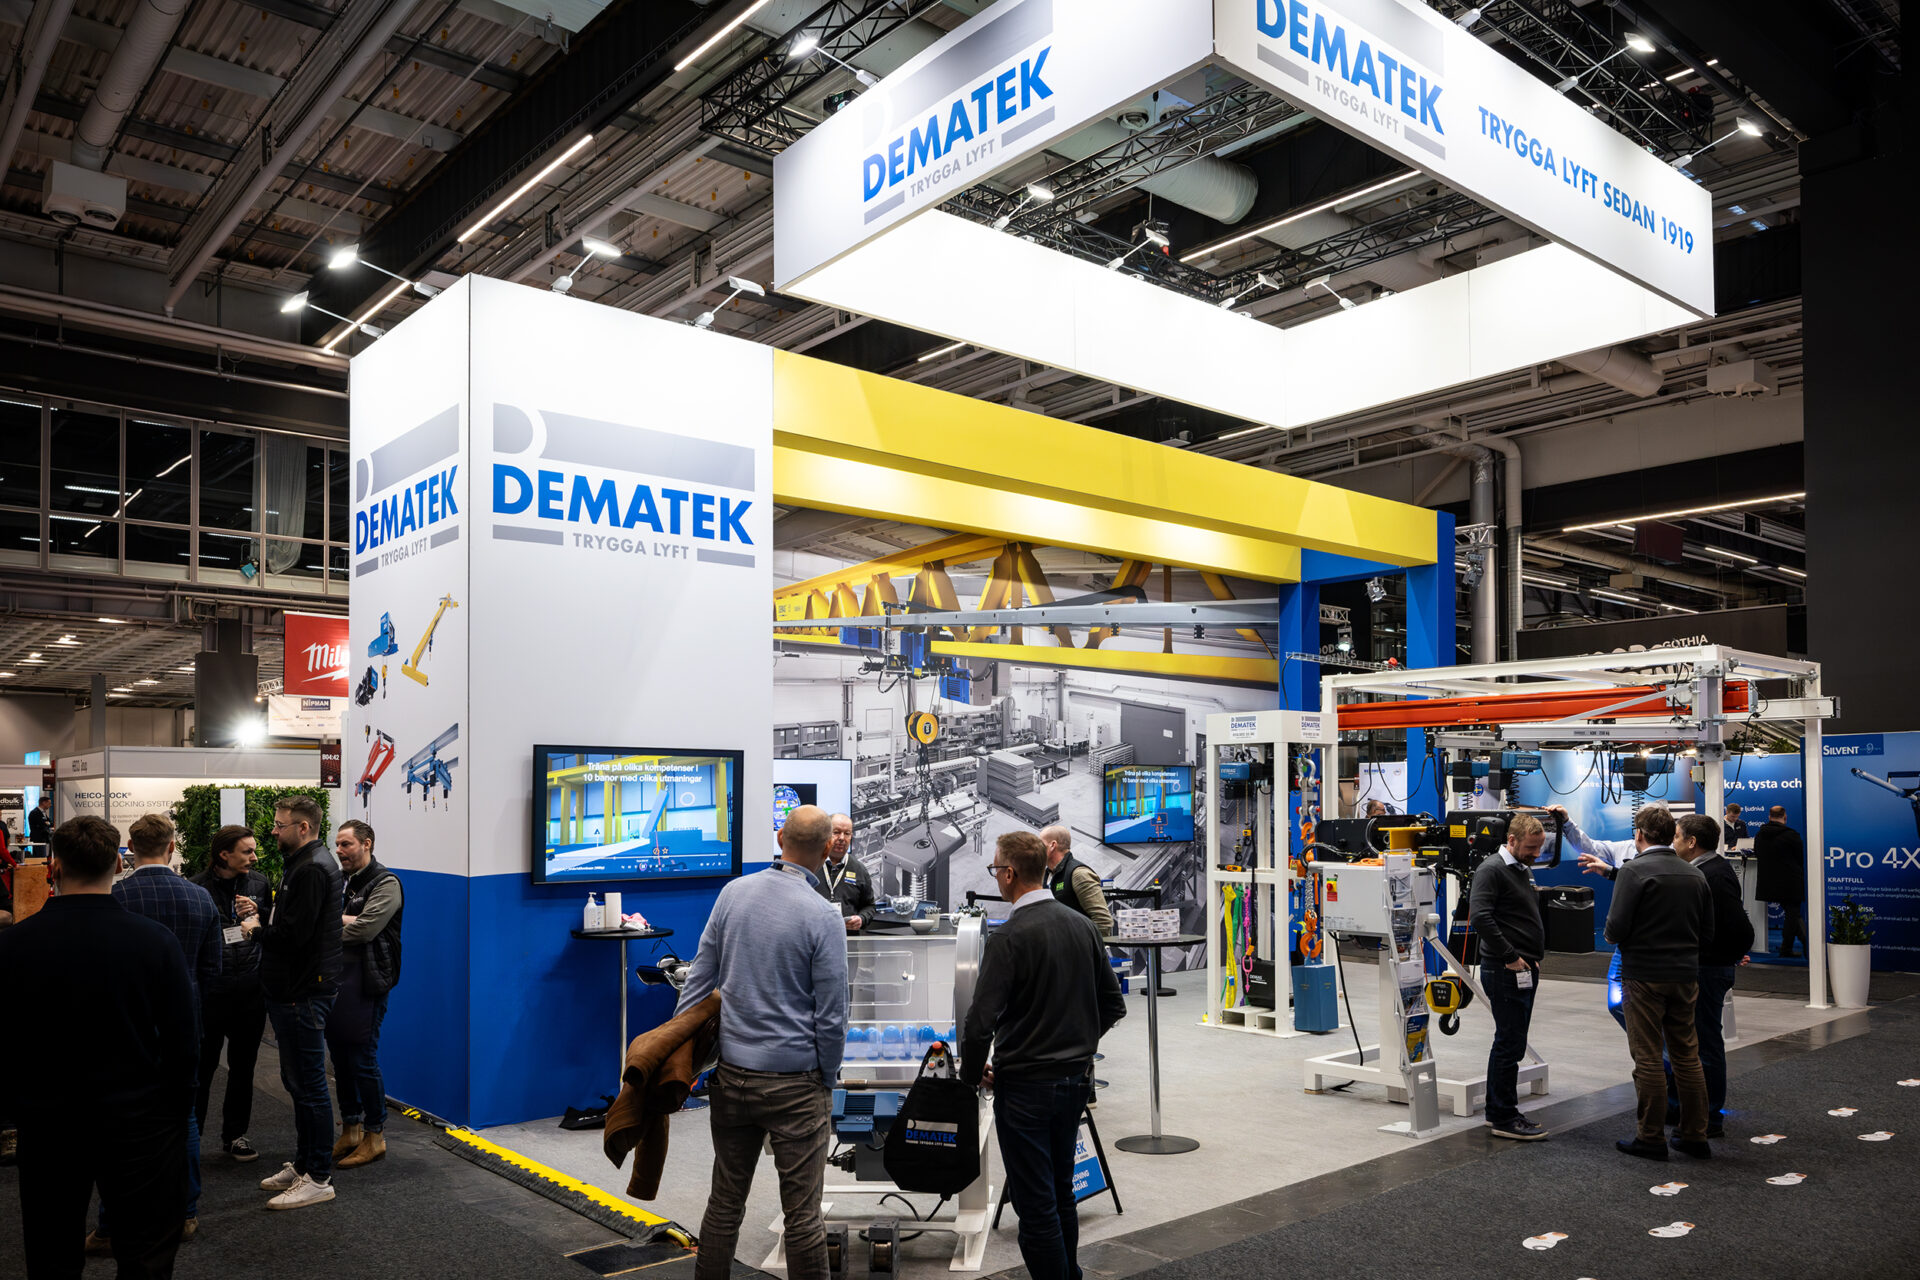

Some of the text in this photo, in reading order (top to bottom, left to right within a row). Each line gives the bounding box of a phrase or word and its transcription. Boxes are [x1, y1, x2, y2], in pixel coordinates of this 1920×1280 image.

[1257, 0, 1445, 135] DEMATEK
[1315, 75, 1400, 134] TRYGGA LYFT
[864, 45, 1054, 203] DEMATEK
[910, 138, 996, 198] TRYGGA LYFT
[1479, 105, 1695, 255] TRYGGA LYFT SEDAN 1919
[355, 464, 459, 556] DEMATEK
[492, 463, 755, 545] DEMATEK
[380, 537, 428, 568] TRYGGA LYFT
[573, 532, 690, 560] TRYGGA LYFT
[1662, 634, 1709, 649] GOTHIA
[1231, 721, 1257, 729] DEMATEK
[1823, 744, 1860, 756] SILVENT
[583, 773, 703, 783] 10 banor med olika utmaningar
[587, 762, 610, 771] Träna
[612, 763, 622, 772] på
[624, 763, 642, 771] olika
[644, 763, 694, 773] kompetenser
[1748, 779, 1778, 791] tysta
[1781, 778, 1802, 788] och
[1825, 847, 1874, 868] Pro
[905, 1129, 957, 1143] DEMATEK
